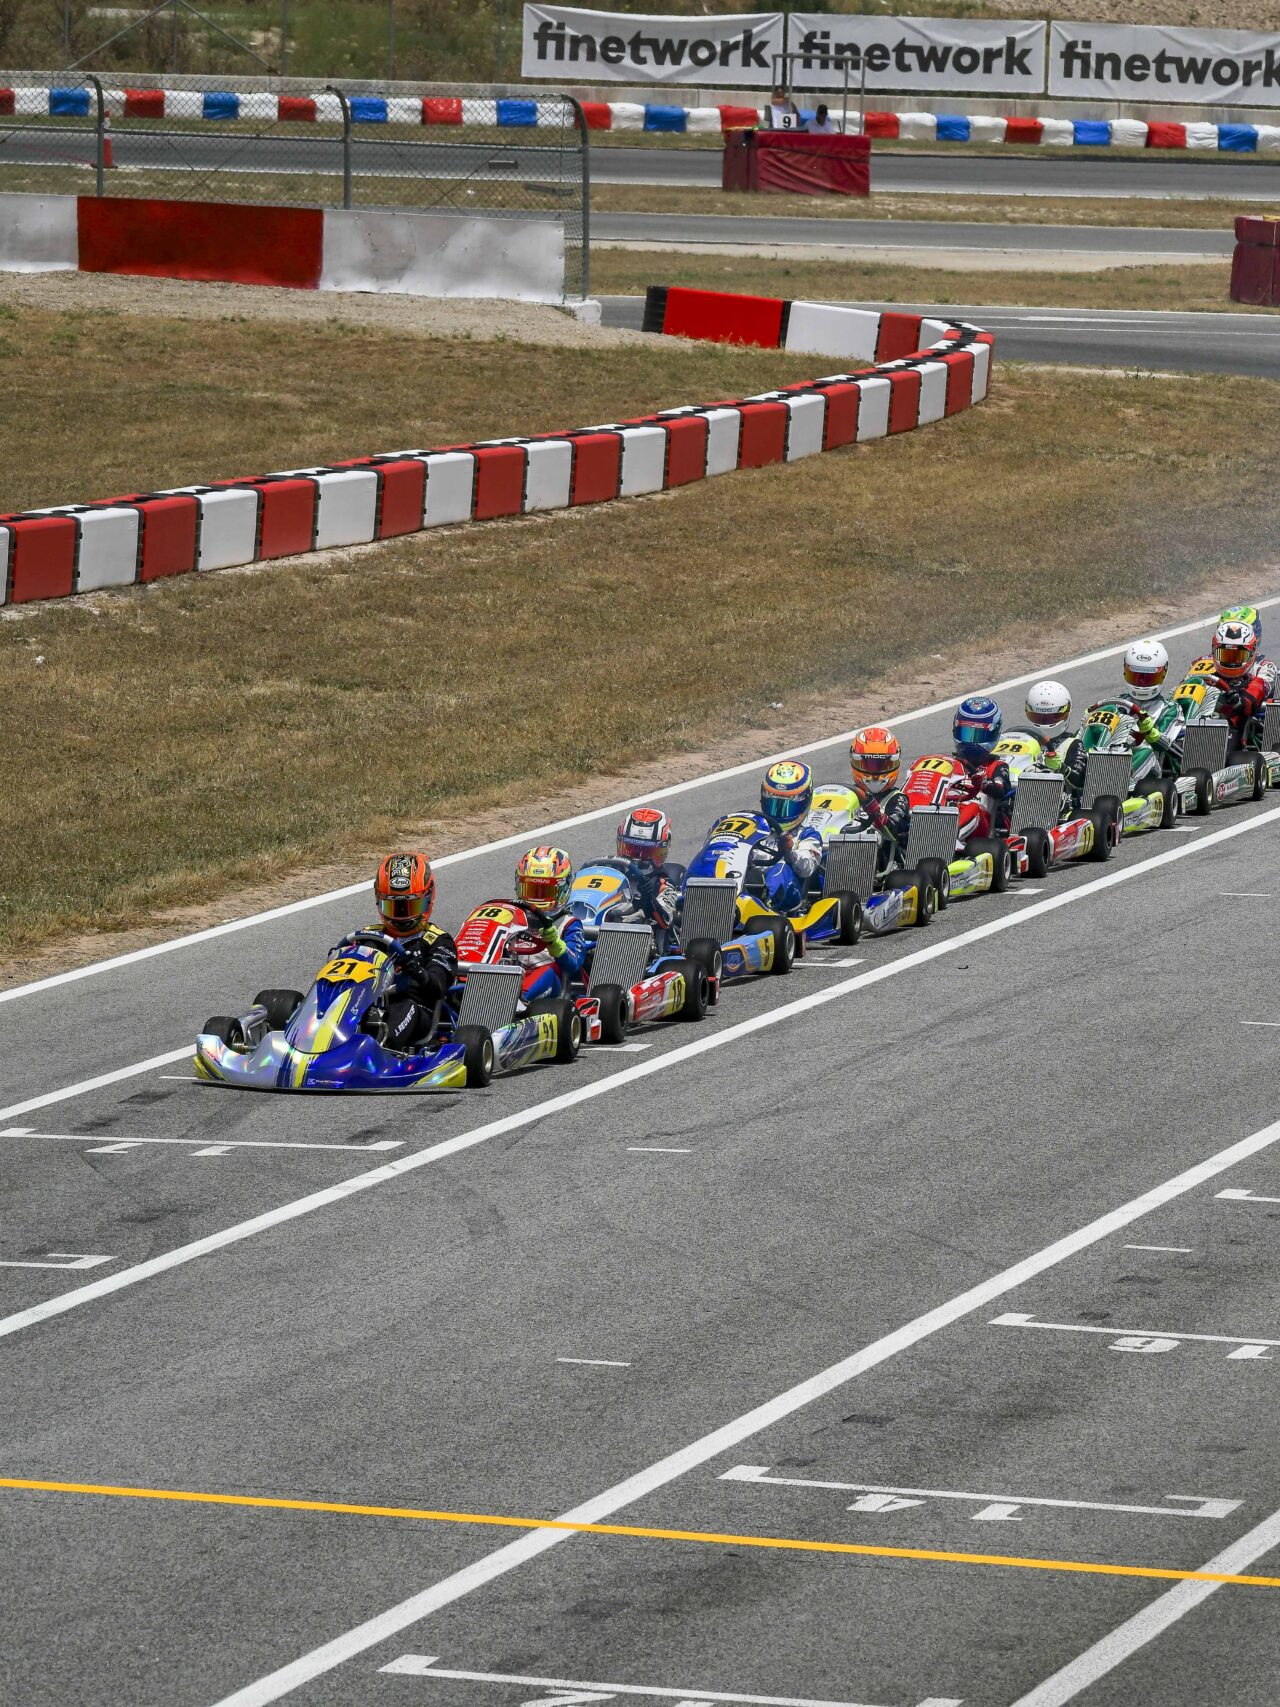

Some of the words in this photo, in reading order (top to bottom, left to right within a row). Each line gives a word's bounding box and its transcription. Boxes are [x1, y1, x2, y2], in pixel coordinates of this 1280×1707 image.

[532, 21, 770, 68] finetwork
[798, 30, 1033, 76] finetwork
[782, 115, 791, 128] 9
[1195, 662, 1215, 671] 37
[1180, 684, 1197, 695] 11
[1087, 711, 1115, 725] 38
[920, 760, 944, 770] 17
[818, 799, 832, 809] 4
[716, 820, 750, 833] 57
[588, 878, 604, 889] 5
[475, 907, 503, 918] 18
[329, 961, 357, 976] 21
